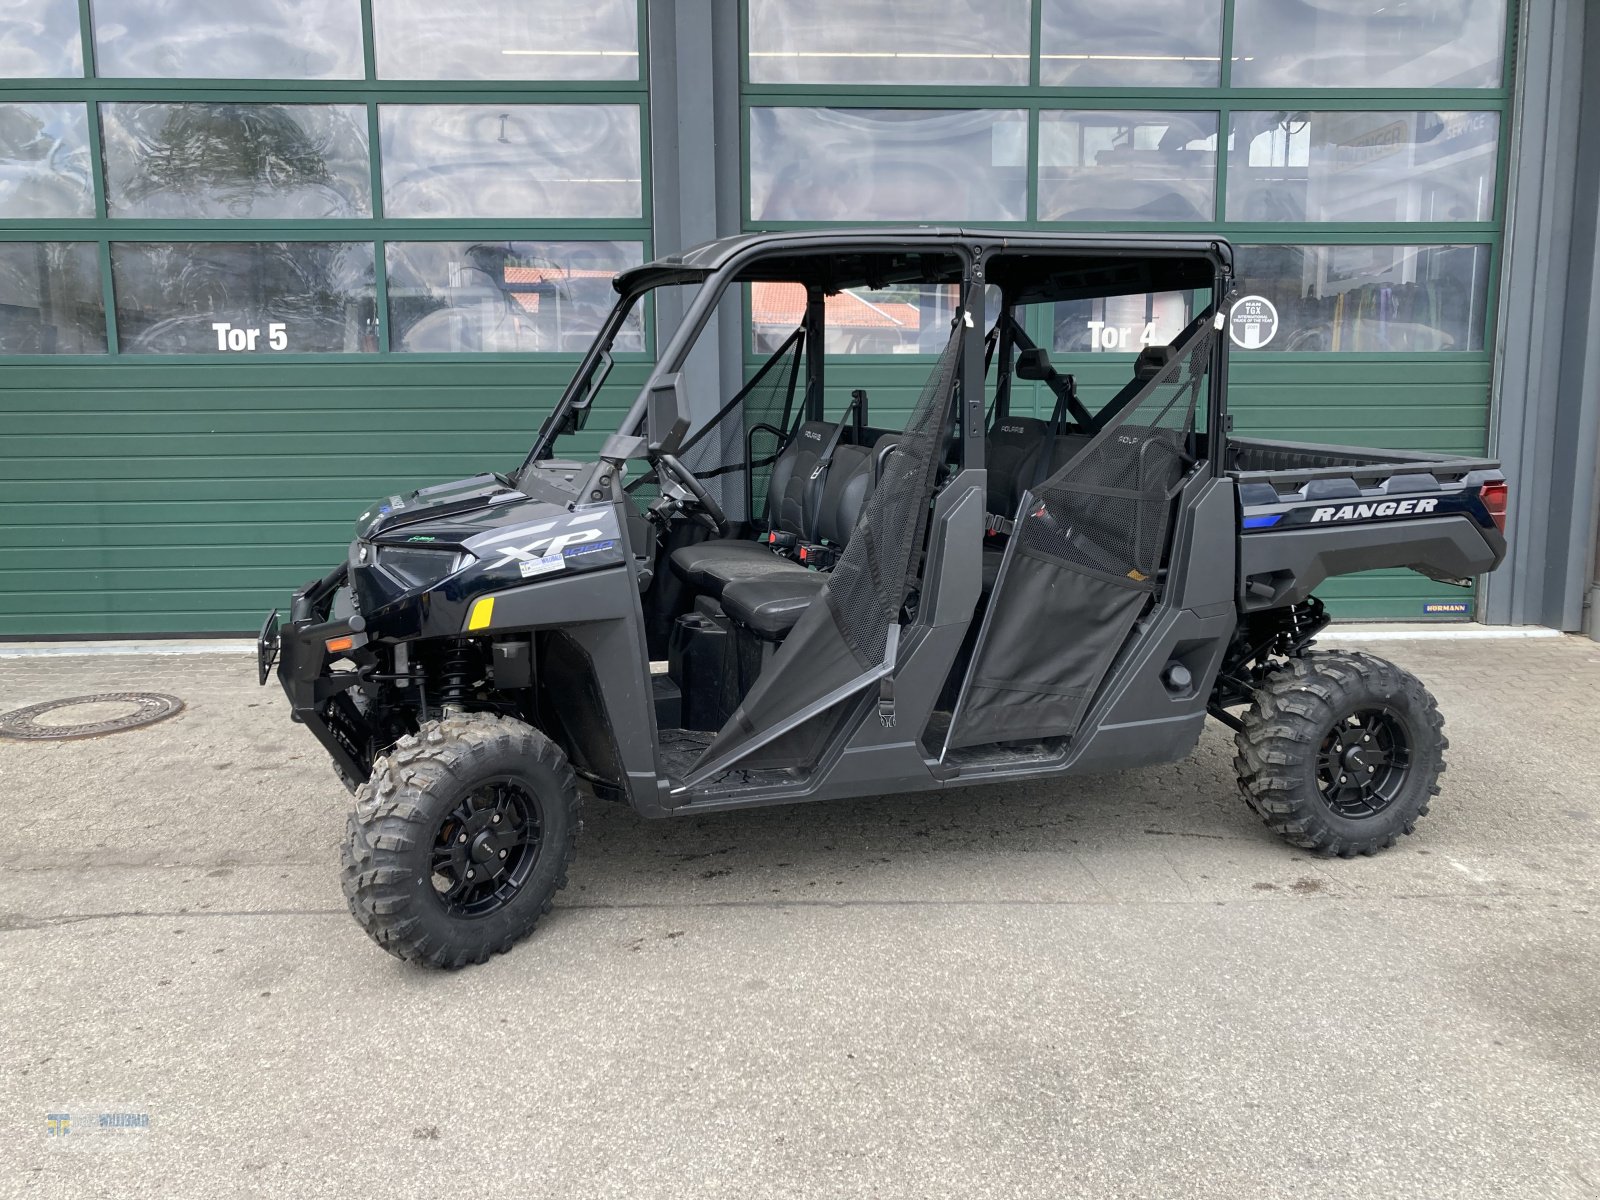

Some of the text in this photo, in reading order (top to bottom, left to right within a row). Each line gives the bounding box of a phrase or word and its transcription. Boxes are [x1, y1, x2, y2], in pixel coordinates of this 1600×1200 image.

[1447, 114, 1486, 141] SERVICE
[1245, 306, 1261, 315] TGX
[212, 322, 288, 351] Tor 5
[1087, 321, 1158, 349] Tor 4
[1310, 498, 1439, 523] RANGER
[482, 528, 603, 571] XP
